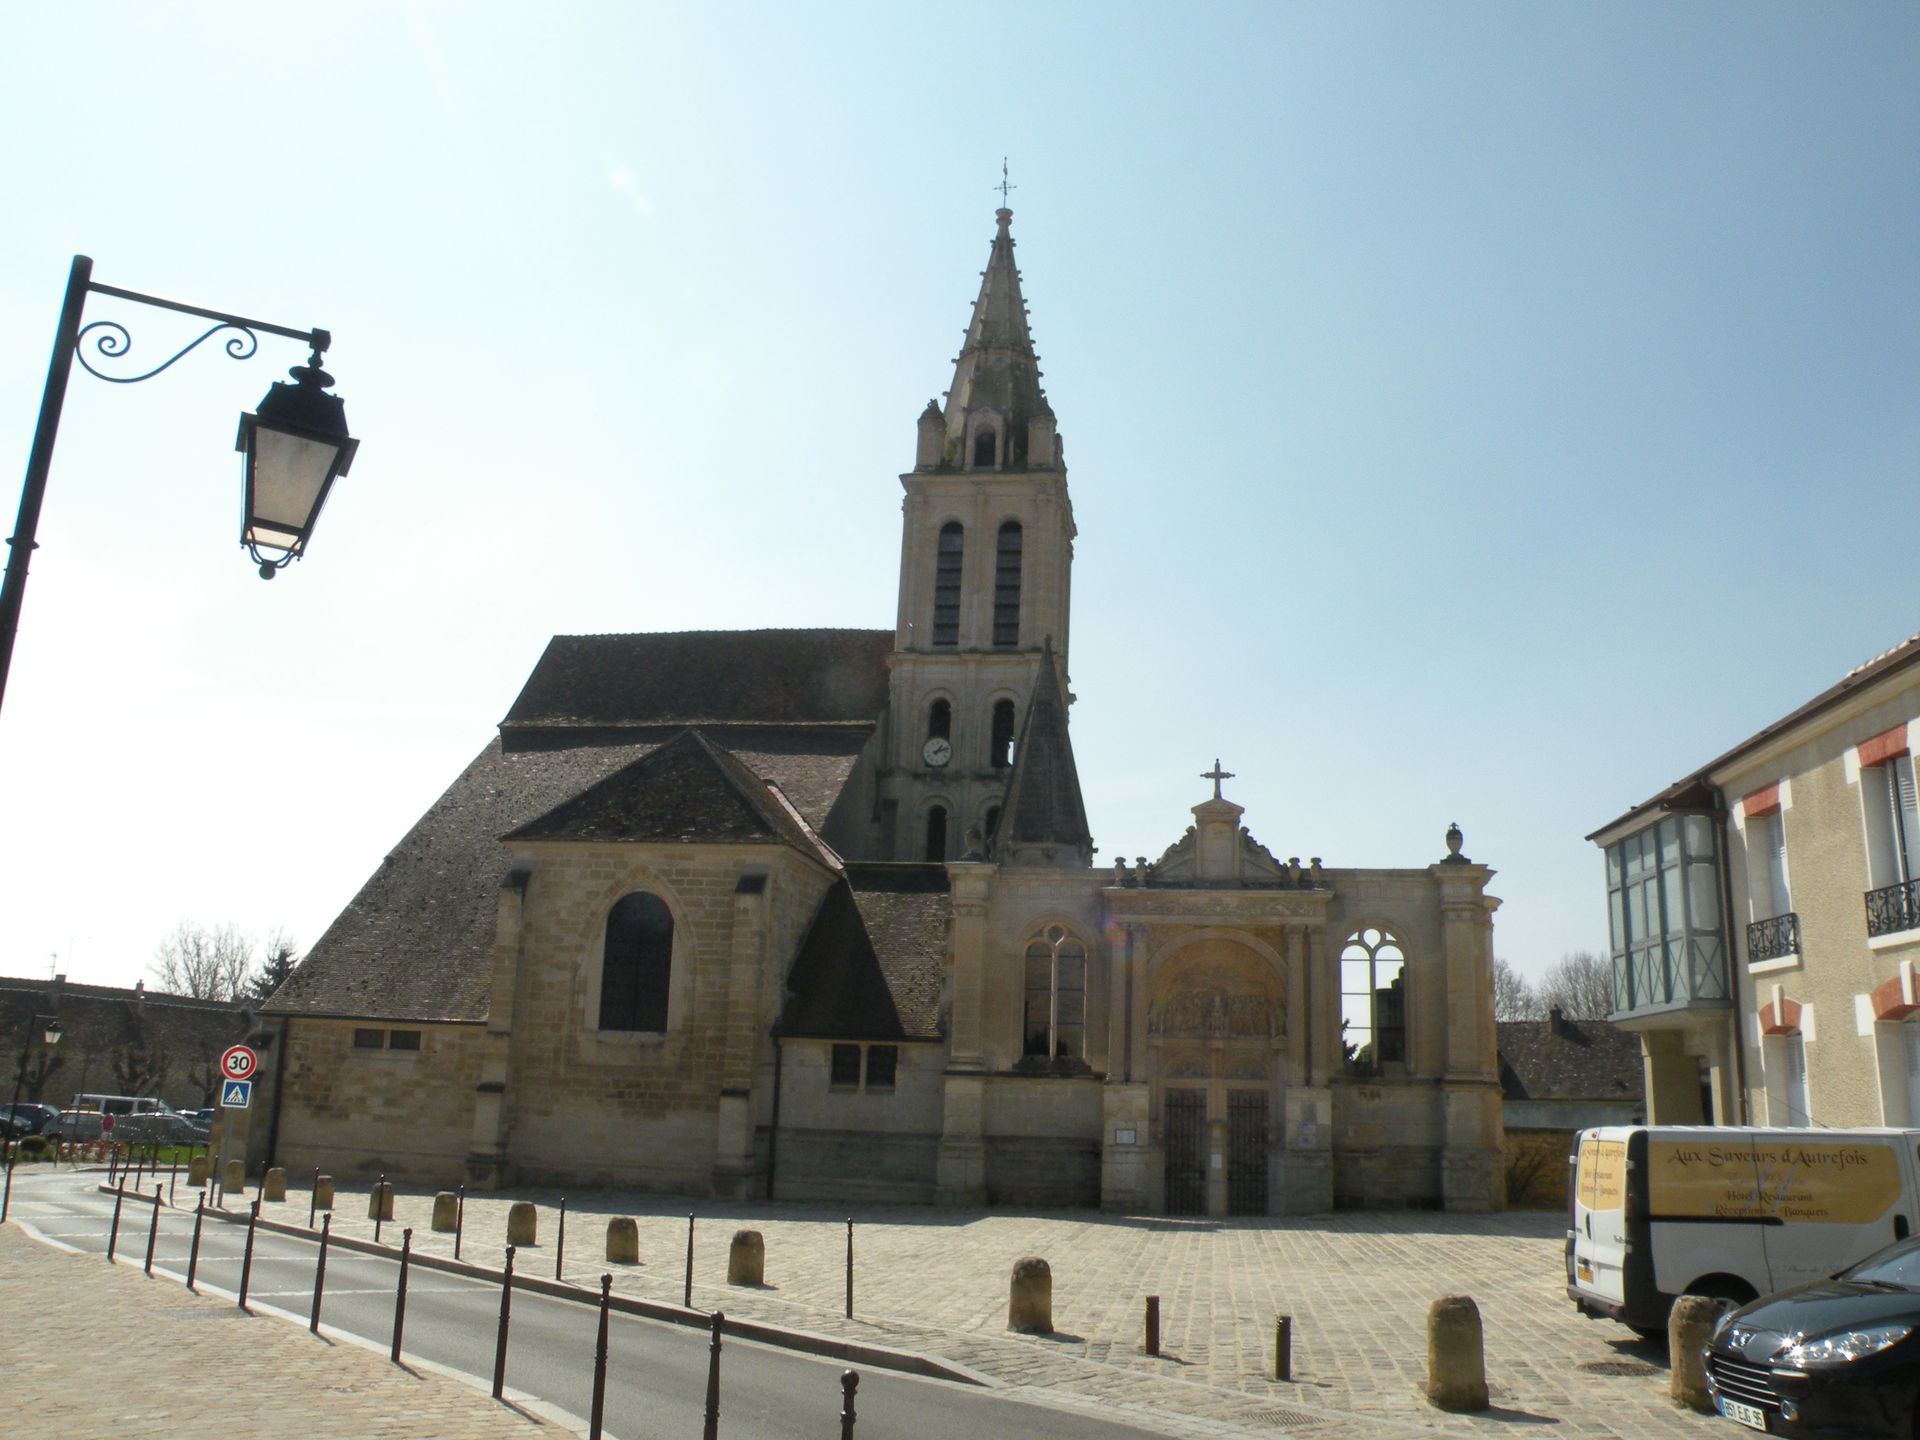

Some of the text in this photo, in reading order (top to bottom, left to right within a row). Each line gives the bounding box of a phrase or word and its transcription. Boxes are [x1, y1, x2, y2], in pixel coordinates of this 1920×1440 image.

[229, 1056, 249, 1070] 30
[1668, 1148, 1703, 1166] Aux
[1709, 1147, 1777, 1167] Saveurs
